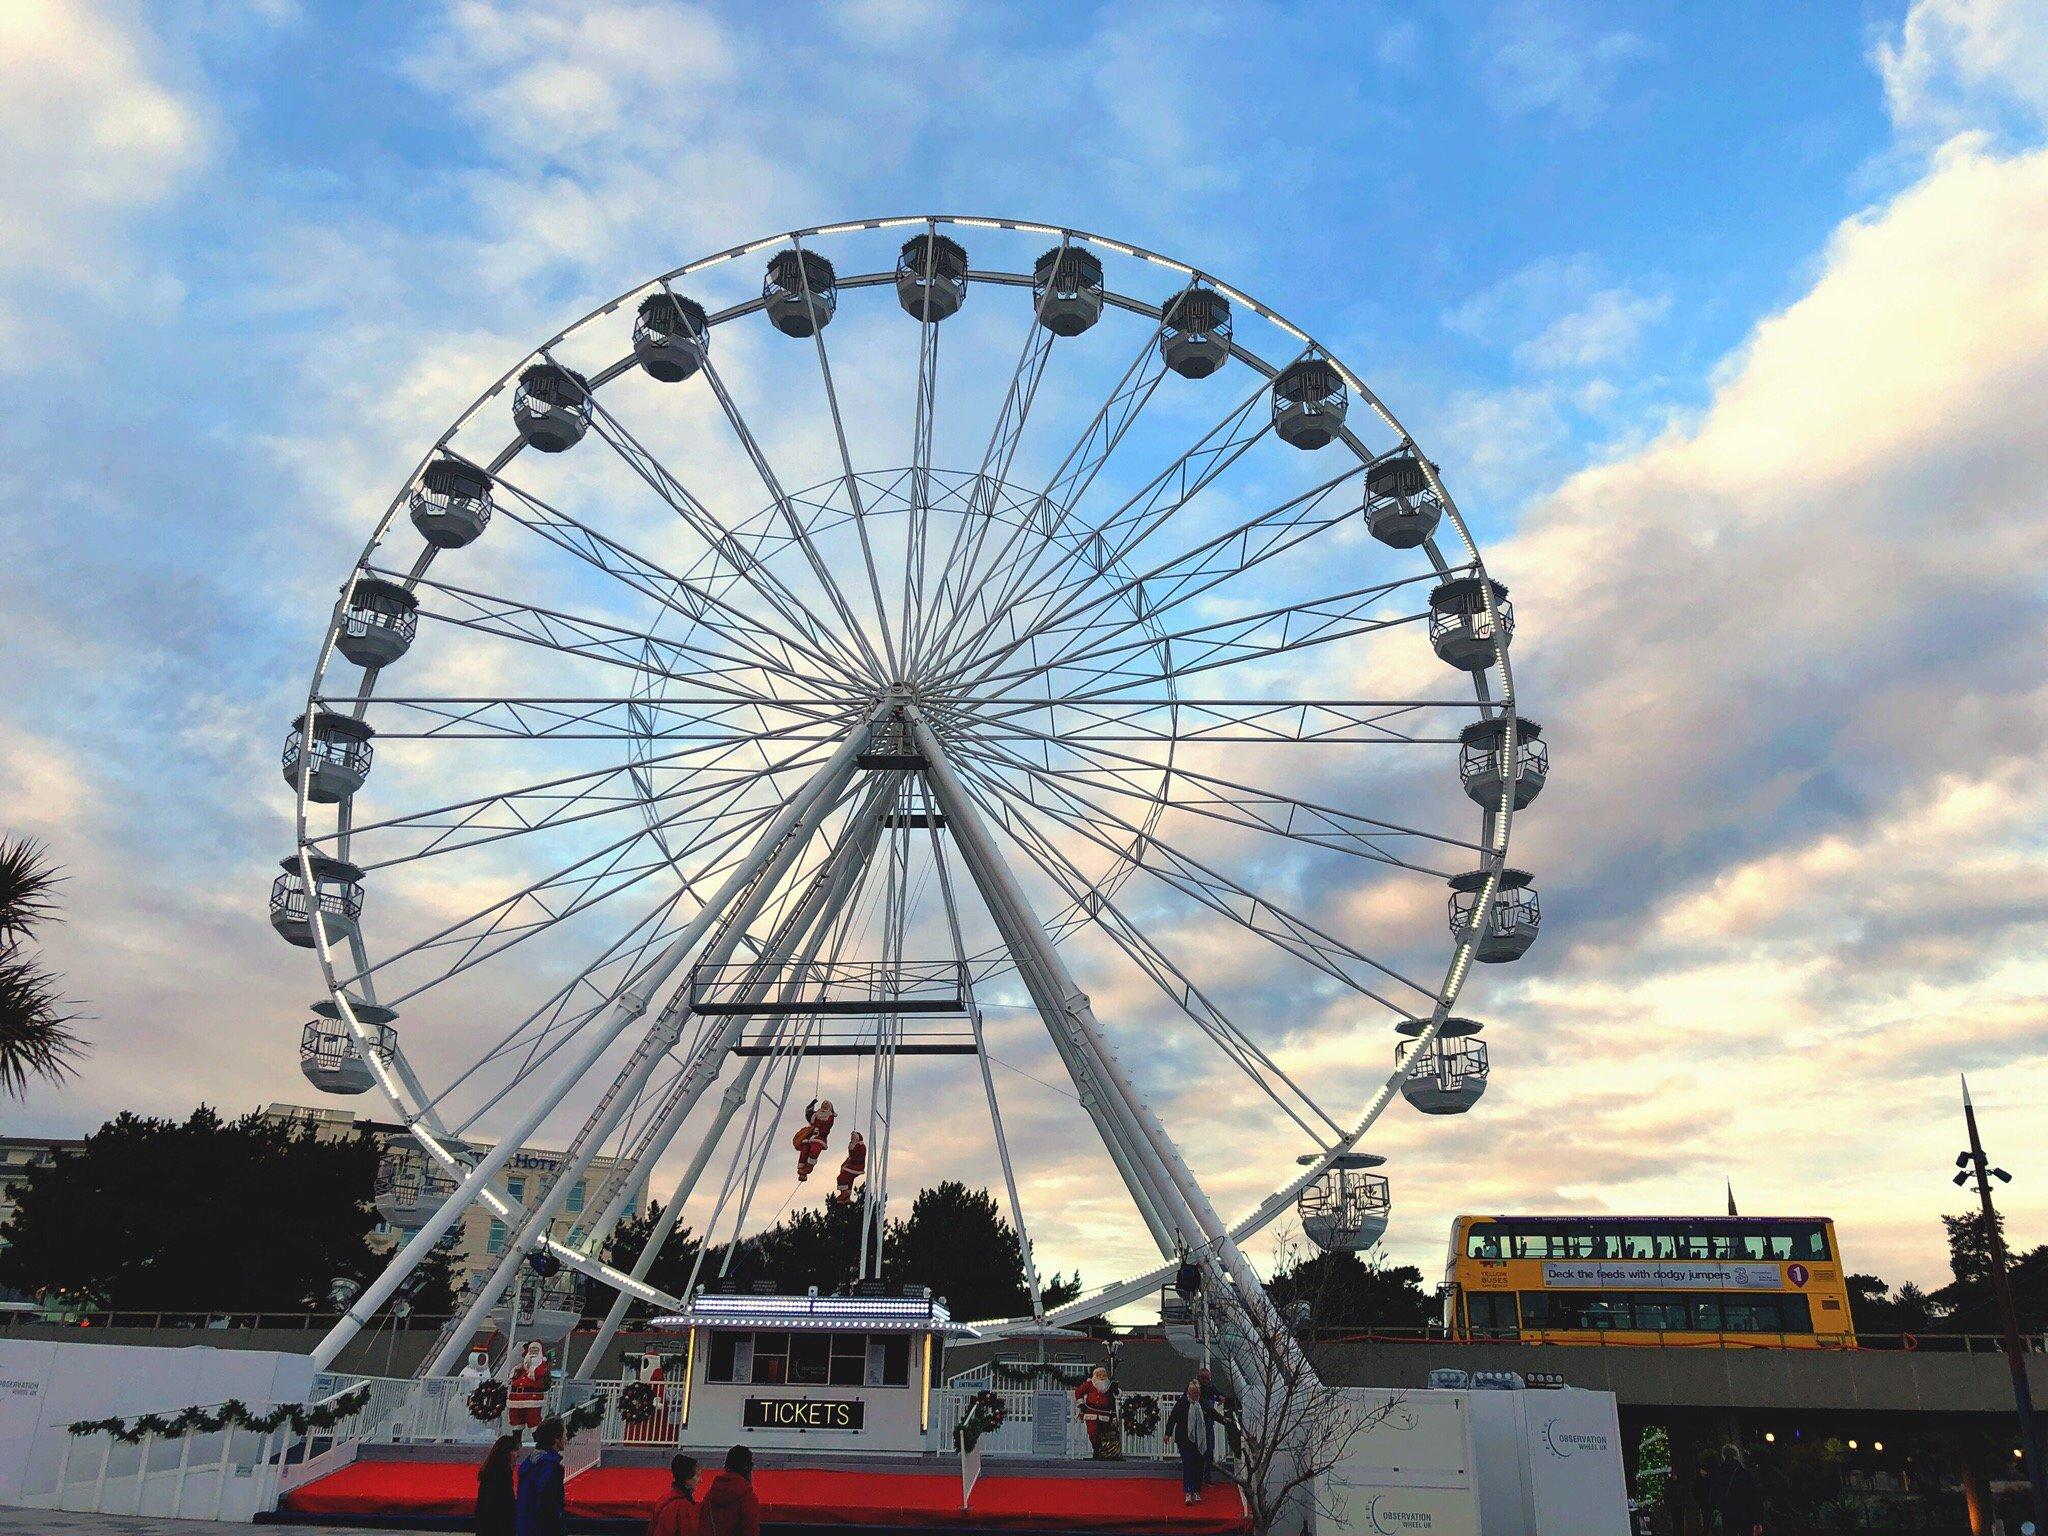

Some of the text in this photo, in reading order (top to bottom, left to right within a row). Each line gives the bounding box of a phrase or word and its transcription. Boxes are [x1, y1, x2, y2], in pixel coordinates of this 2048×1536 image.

[1548, 1269, 1732, 1281] Deck the feeds with dodgy jumpers
[1793, 1266, 1803, 1282] 1
[760, 1401, 849, 1425] TICKETS
[1559, 1434, 1607, 1444] OBSERVATION
[1383, 1511, 1432, 1521] OBSERVATION
